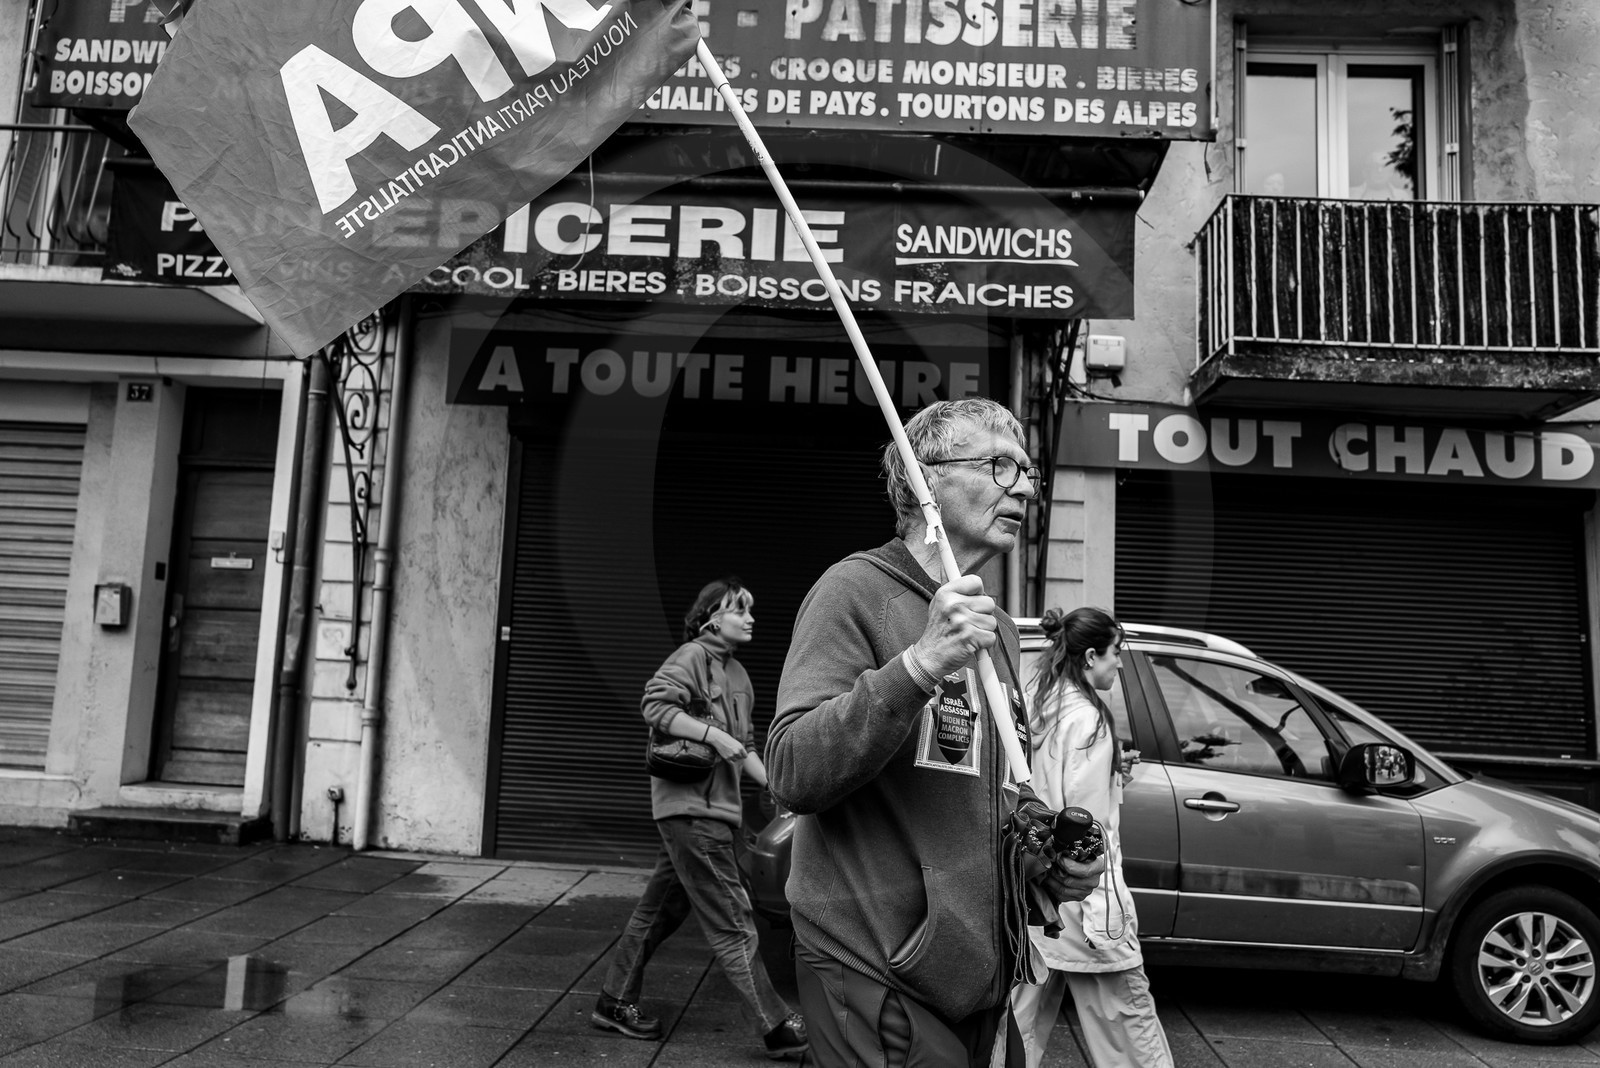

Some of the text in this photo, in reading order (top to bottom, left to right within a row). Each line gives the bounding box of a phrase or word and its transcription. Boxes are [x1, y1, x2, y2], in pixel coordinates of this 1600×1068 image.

[784, 0, 1137, 50] PATISSERIE
[770, 57, 894, 83] CROQUE
[902, 60, 1068, 89] MONSIEUR
[1097, 66, 1199, 93] BIERES
[50, 70, 152, 97] BOISSO
[767, 89, 801, 114] DE
[898, 93, 1046, 121] TOURTONS
[1054, 98, 1106, 124] DES
[1112, 100, 1198, 127] ALPES
[895, 223, 1073, 259] SANDWICHS
[557, 269, 667, 294] BIERES
[694, 274, 882, 302] BOISSONS
[894, 279, 1074, 309] FRAICHES
[130, 385, 150, 400] 37
[477, 346, 981, 407] A TOUTE HEURE
[1108, 412, 1595, 481] TOUT CHAUD
[940, 704, 970, 717] ASSASSIN
[942, 715, 968, 727] BIDEN ET
[938, 731, 970, 744] COMPLICES
[941, 723, 969, 736] MACRON
